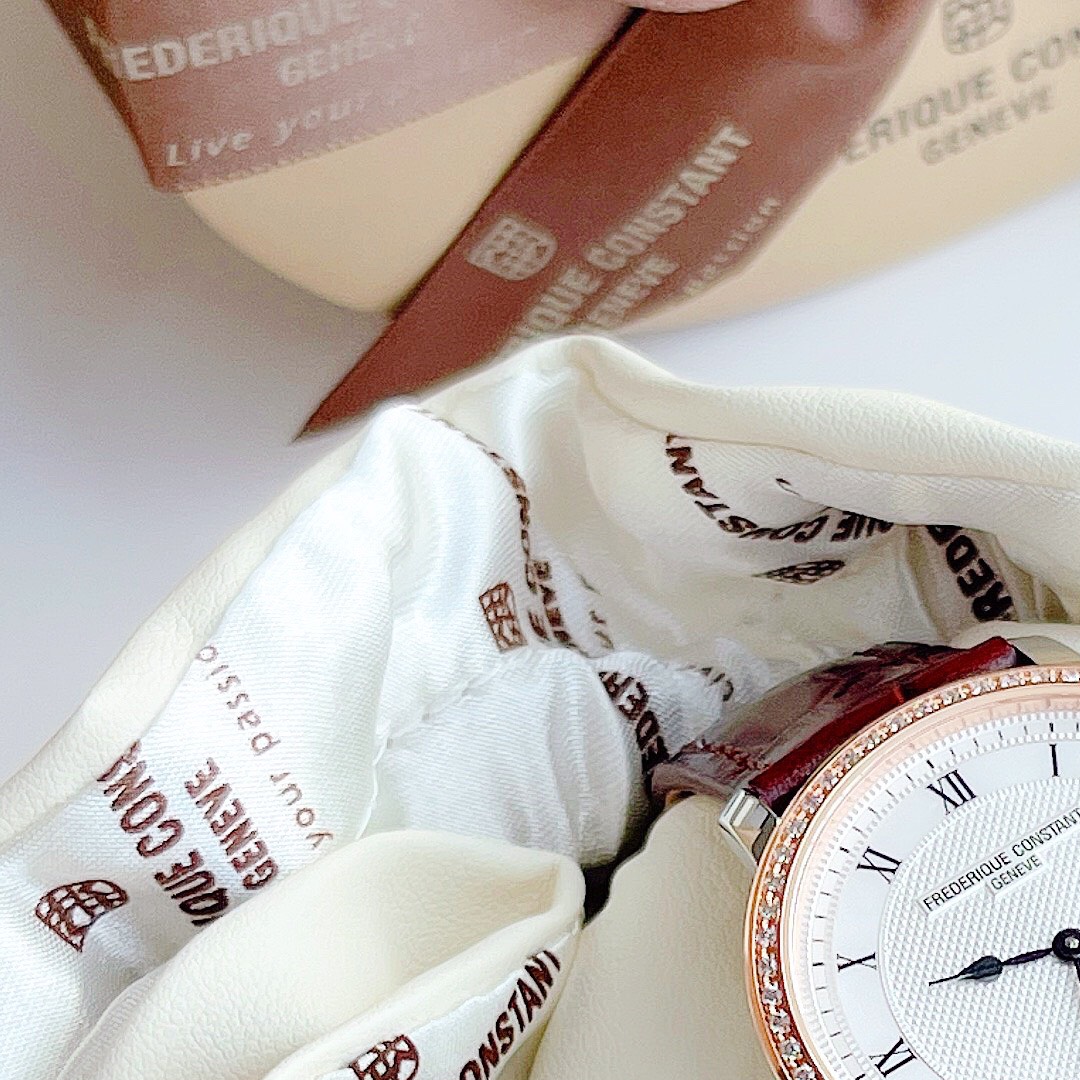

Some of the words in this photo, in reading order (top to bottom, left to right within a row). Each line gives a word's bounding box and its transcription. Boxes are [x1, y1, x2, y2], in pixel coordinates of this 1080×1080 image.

[112, 0, 361, 81] EDERIQUE
[165, 131, 254, 167] Live
[584, 124, 752, 272] CONSTANT
[665, 434, 831, 543] CONSTAN
[269, 771, 334, 850] your
[927, 769, 978, 815] XII
[184, 757, 280, 891] GENEVE
[856, 846, 902, 884] XI
[922, 851, 1013, 913] FREDERIQUE
[989, 854, 1044, 892] GENEVE
[836, 951, 878, 975] X
[868, 1037, 917, 1078] IX
